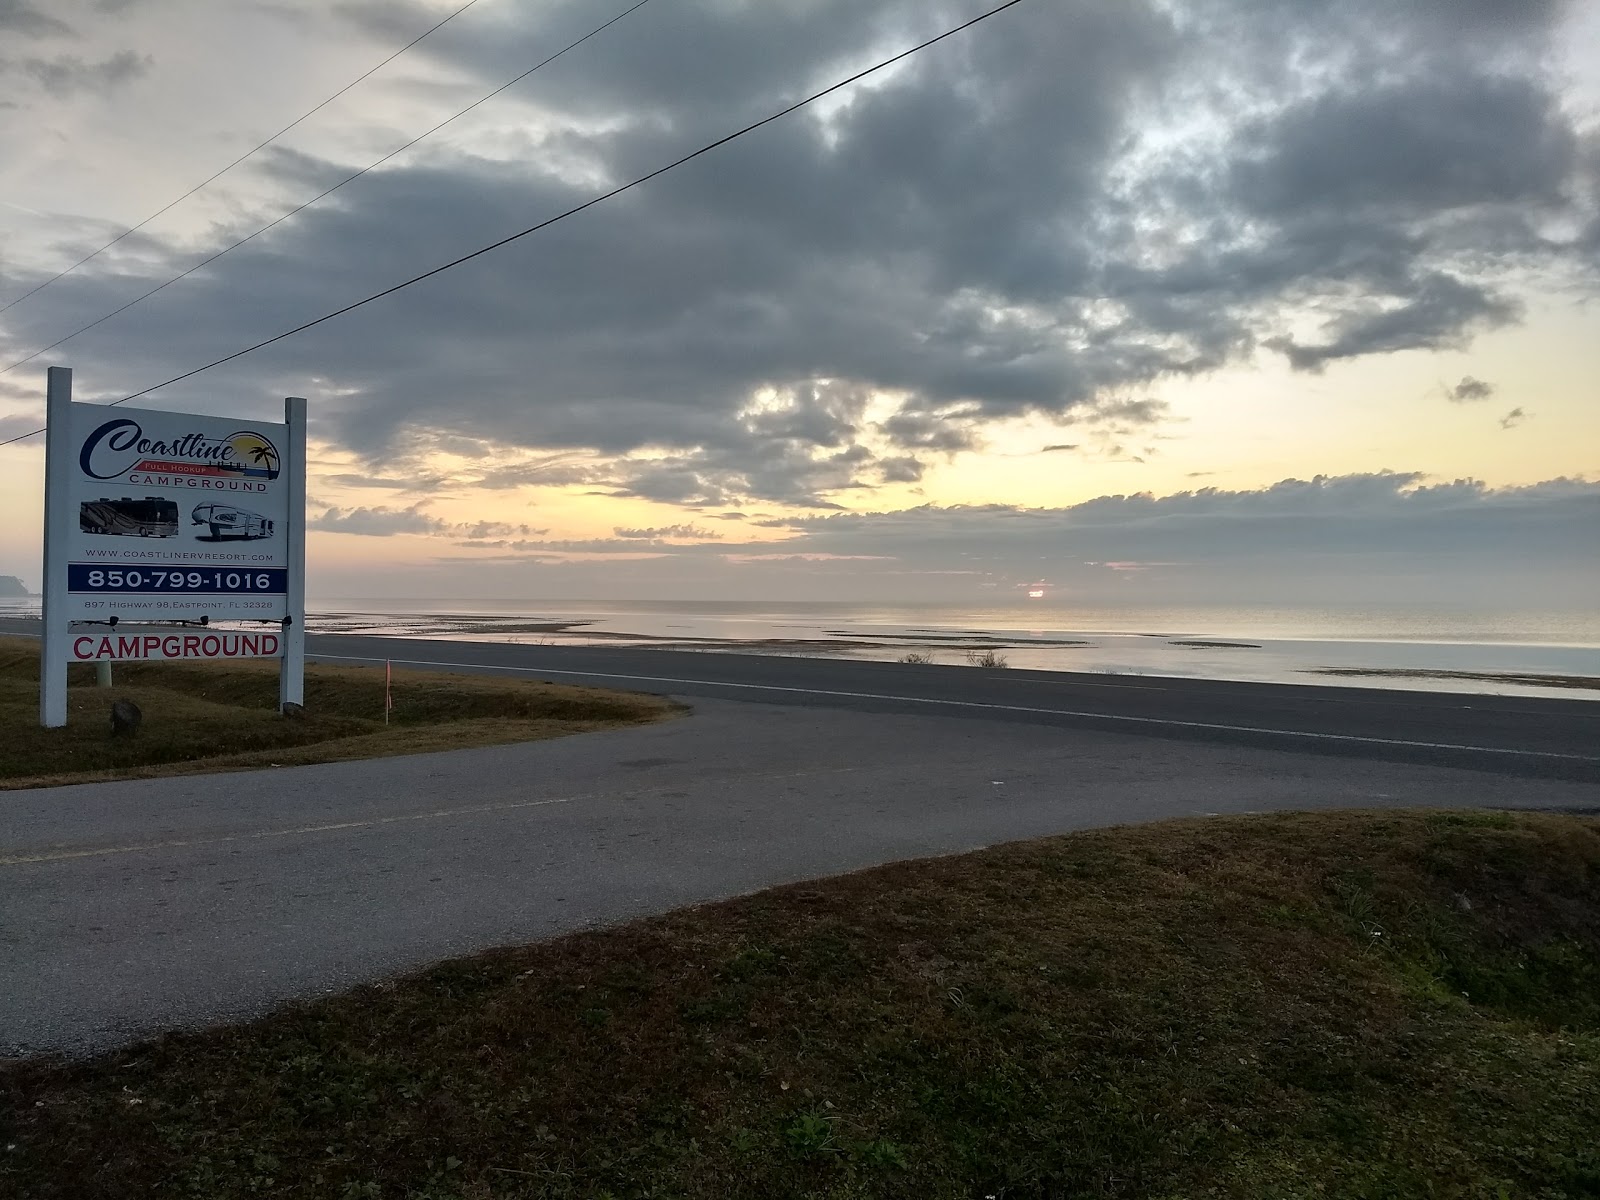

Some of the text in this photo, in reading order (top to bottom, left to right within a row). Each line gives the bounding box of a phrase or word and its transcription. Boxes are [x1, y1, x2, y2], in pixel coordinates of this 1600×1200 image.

[80, 418, 237, 480] Coastline
[129, 474, 267, 492] CAMPGROUND
[85, 549, 273, 561] WWW.COASTLINERVRESORT.COM
[88, 570, 270, 589] 850-799-1016
[84, 601, 105, 609] 897
[73, 634, 279, 660] CAMPGROUND
